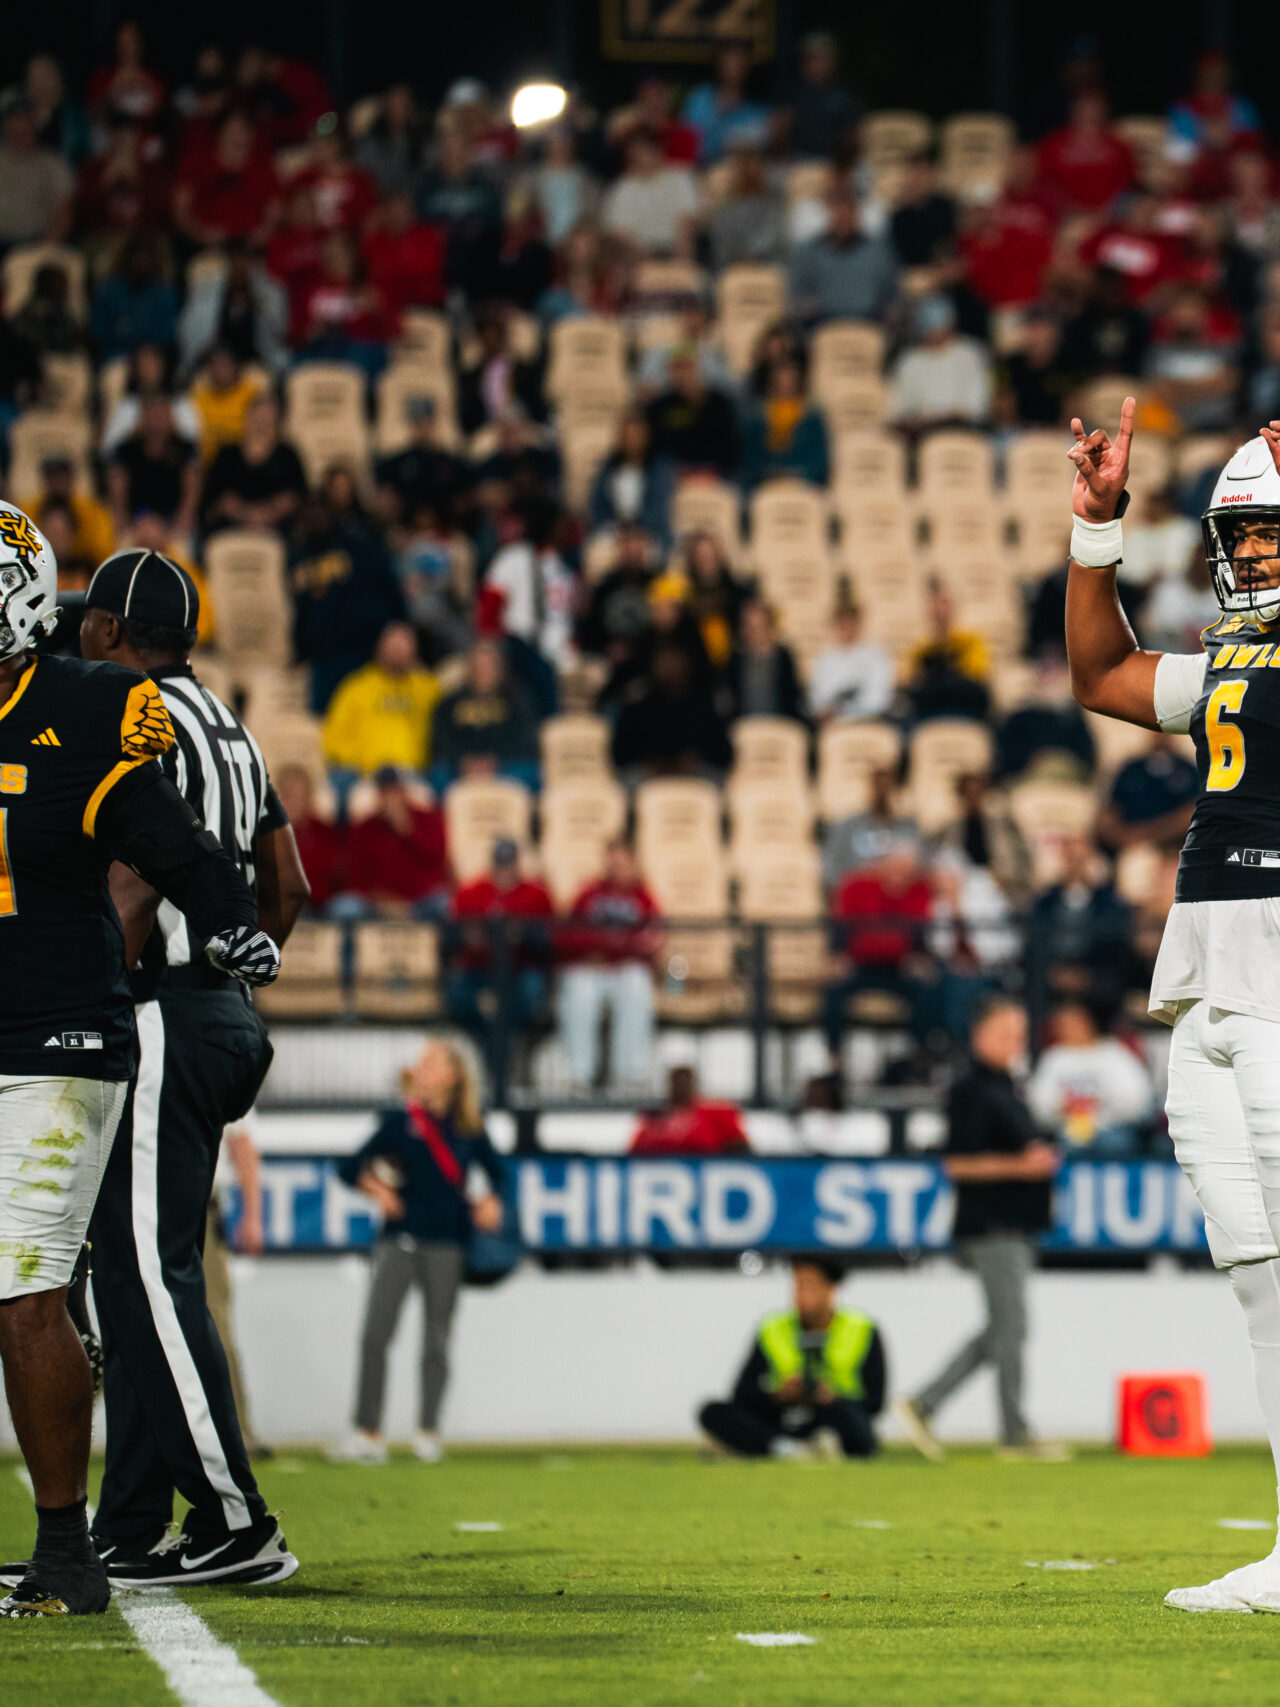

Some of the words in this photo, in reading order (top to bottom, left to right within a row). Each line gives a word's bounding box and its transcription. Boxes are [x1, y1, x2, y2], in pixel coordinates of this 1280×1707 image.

[1221, 494, 1253, 504] Riddell
[1206, 679, 1249, 792] 6
[516, 1159, 777, 1247] HIRD
[1143, 1388, 1180, 1440] G
